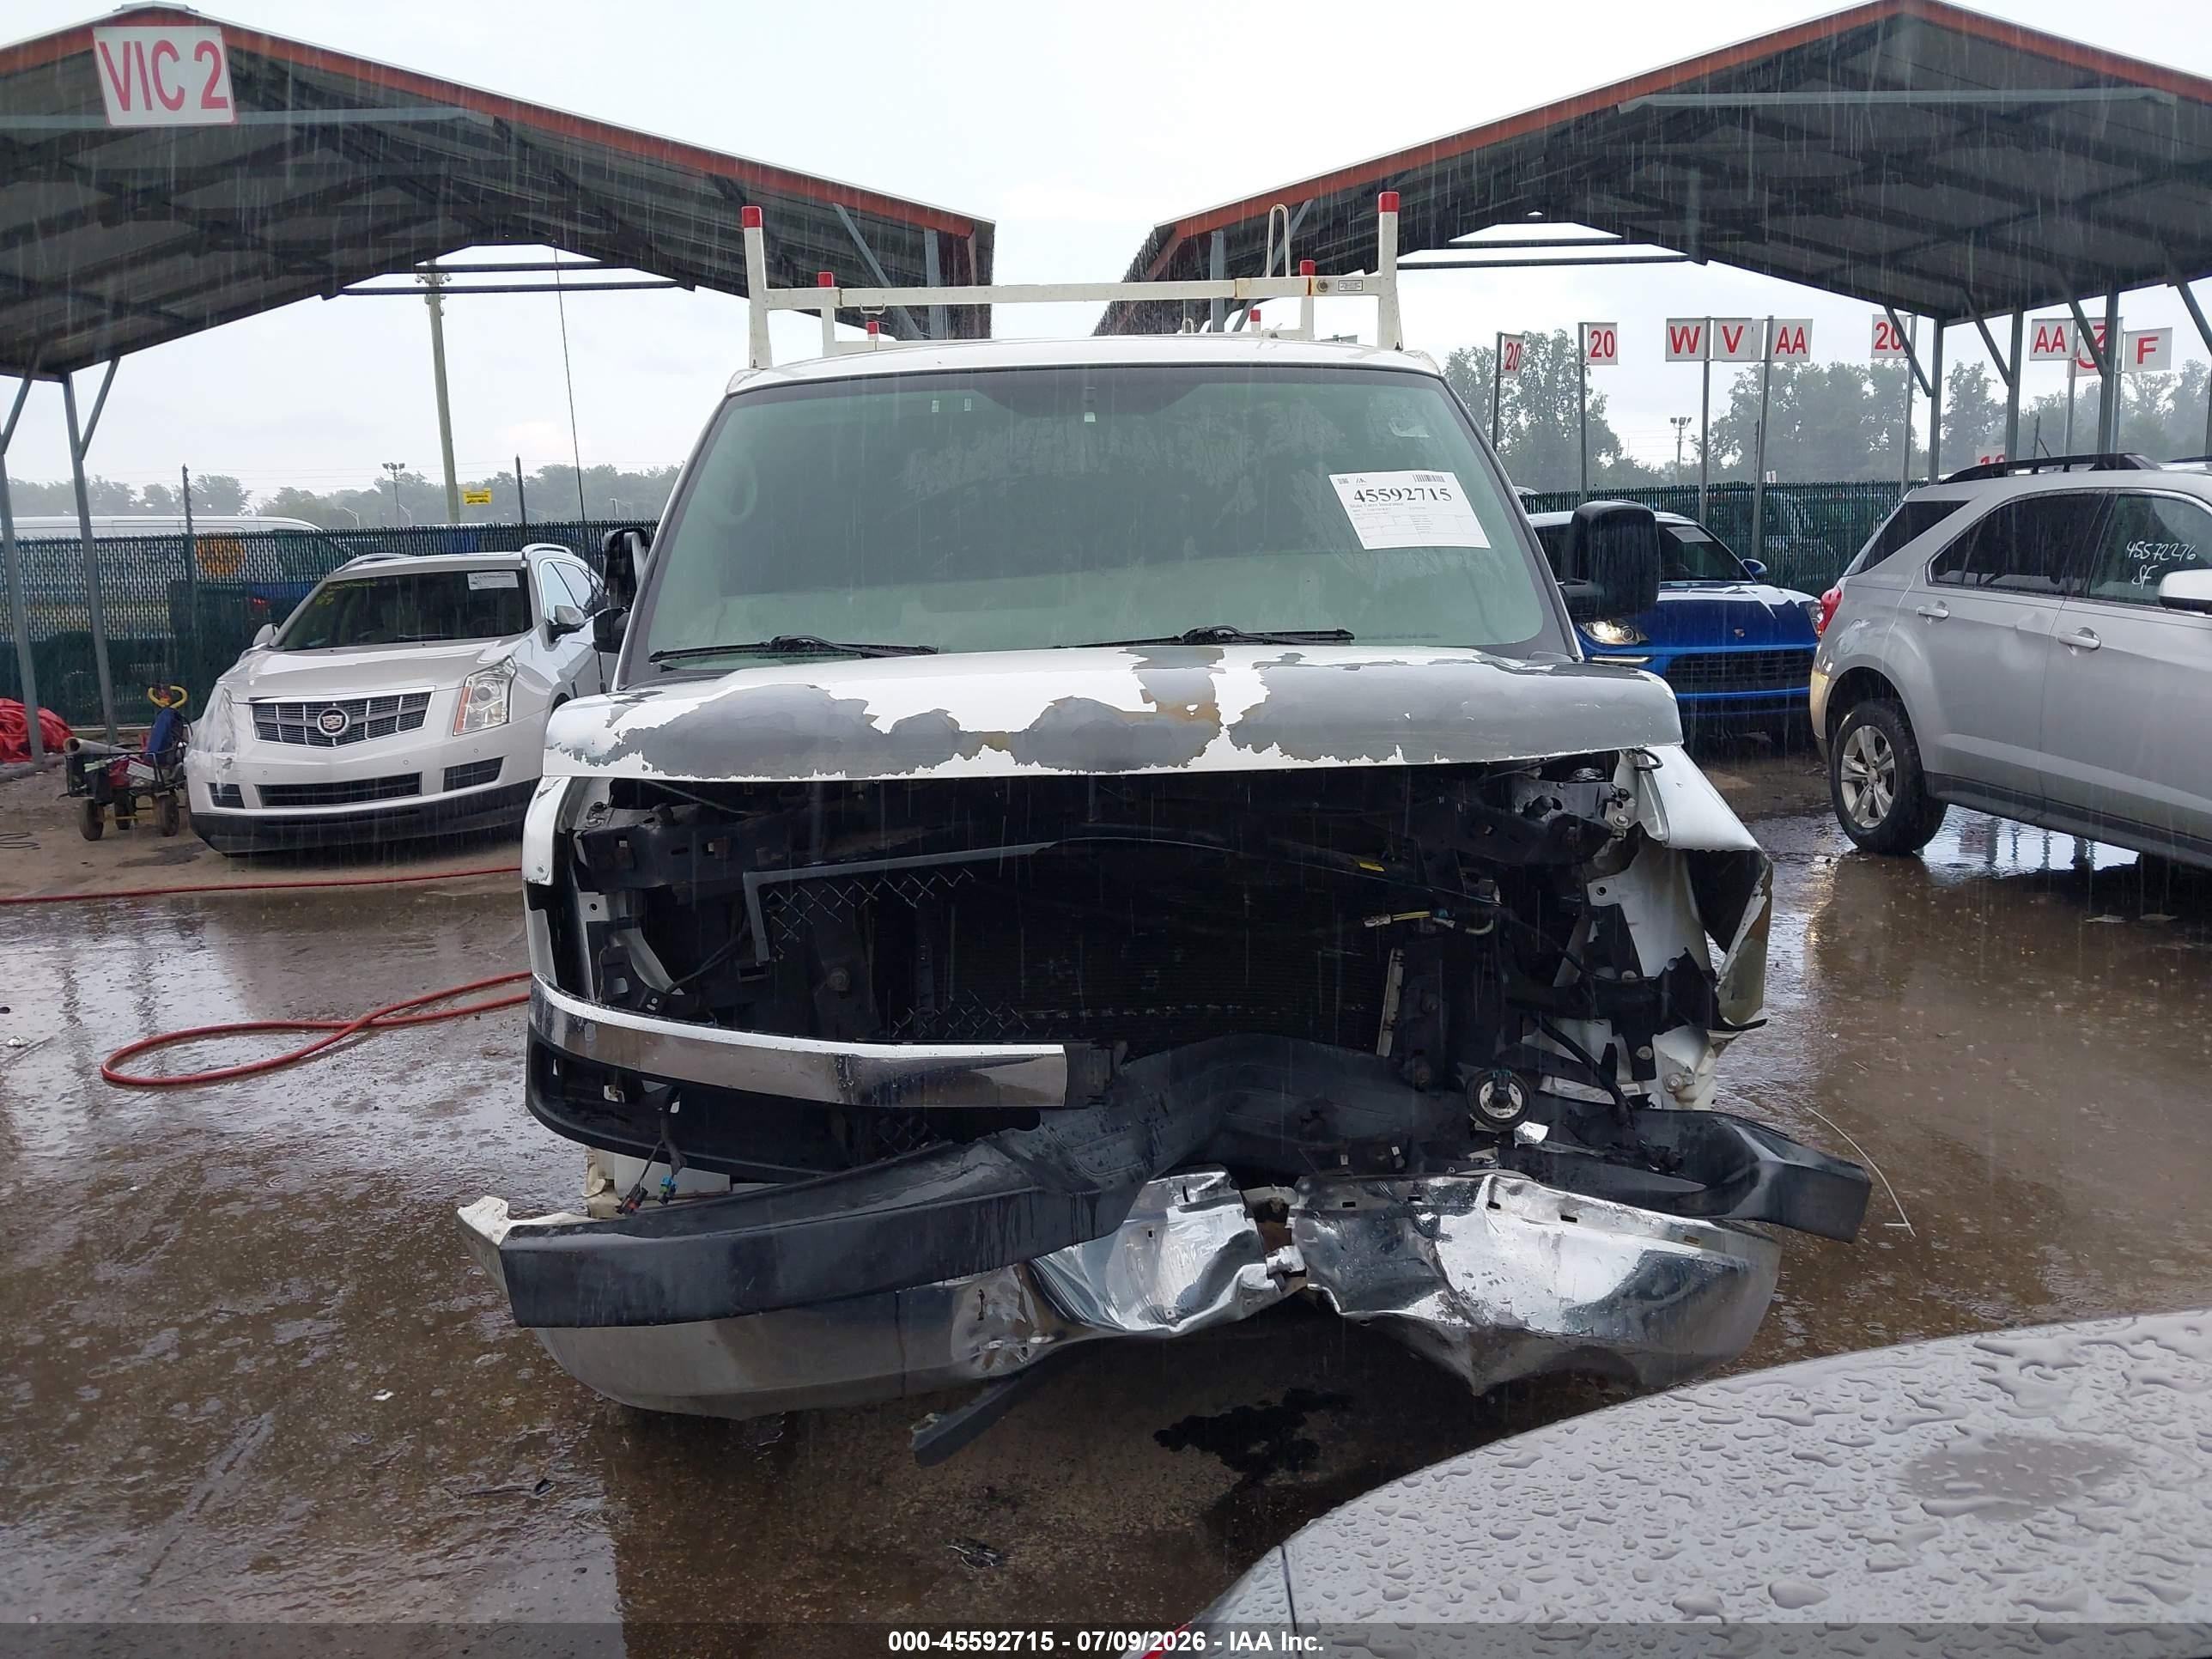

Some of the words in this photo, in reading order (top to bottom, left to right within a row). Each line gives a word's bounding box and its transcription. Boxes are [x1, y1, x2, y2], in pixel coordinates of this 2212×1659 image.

[98, 40, 185, 111] VIC
[194, 40, 228, 110] 2
[1590, 330, 1615, 358] 20
[1669, 325, 1701, 354] W
[1722, 325, 1744, 353] V
[1775, 326, 1807, 354] AA
[2033, 325, 2066, 353] AA
[2136, 336, 2159, 364] F
[1504, 342, 1522, 372] 20
[1353, 487, 1452, 502] 45592715
